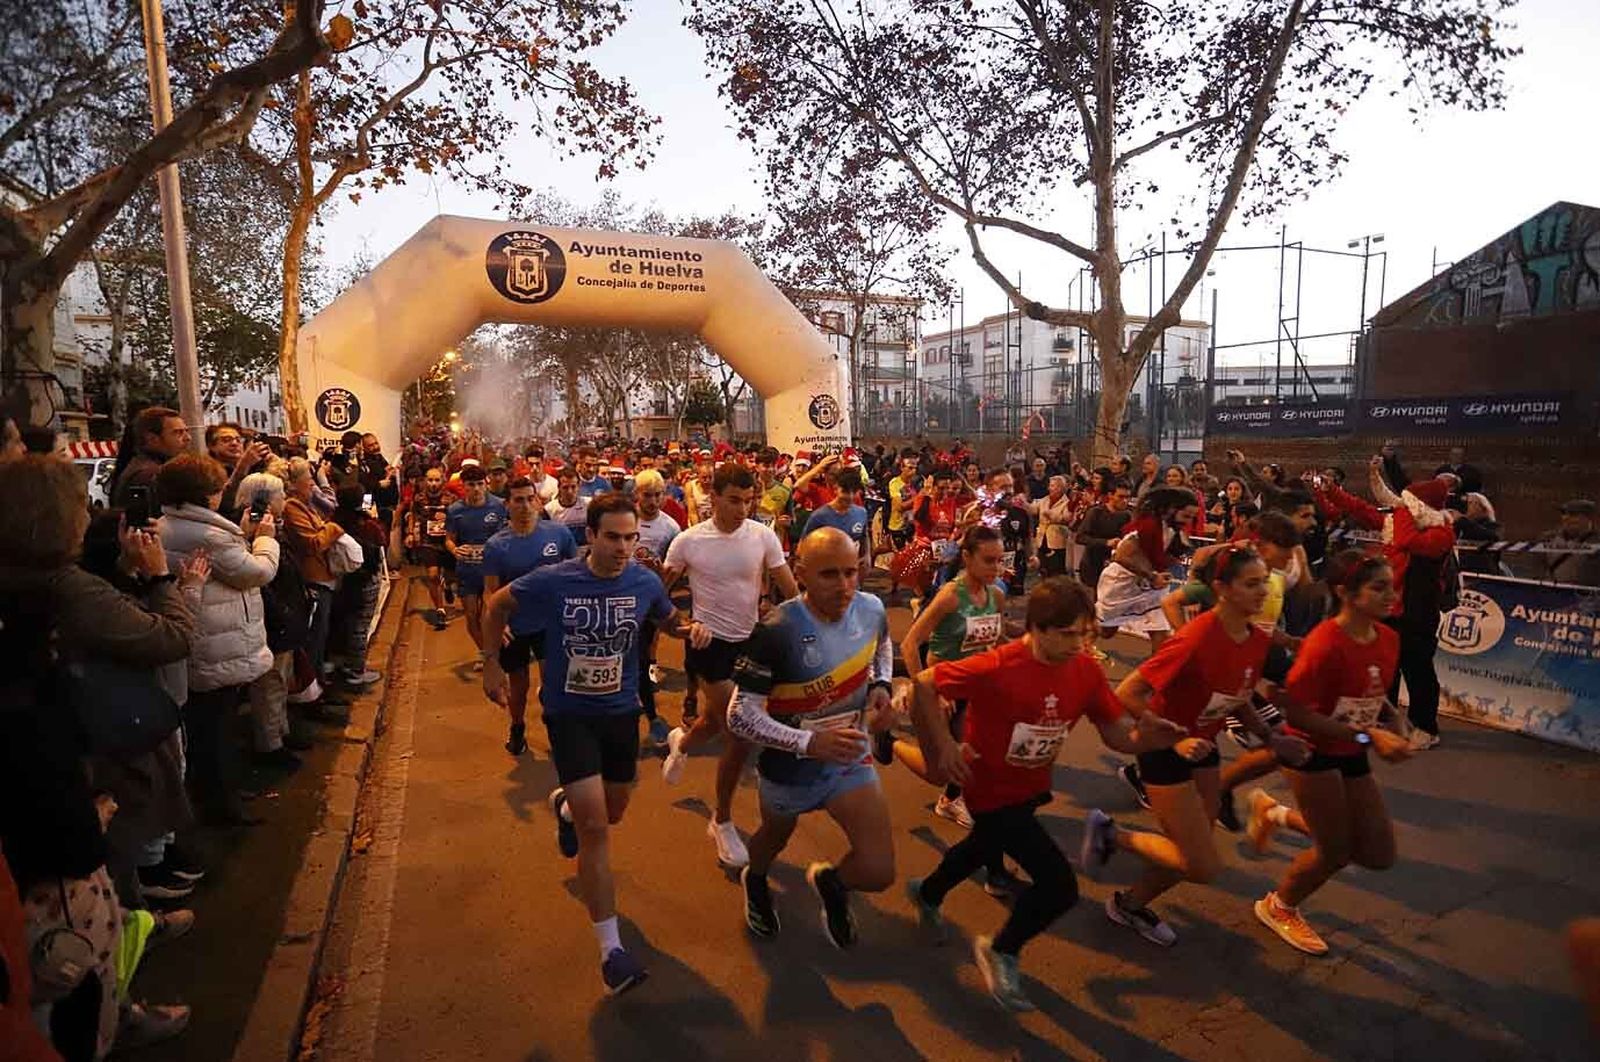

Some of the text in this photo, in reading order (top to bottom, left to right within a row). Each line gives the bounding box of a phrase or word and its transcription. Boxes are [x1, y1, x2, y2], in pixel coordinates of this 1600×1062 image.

[569, 241, 703, 262] Ayuntamiento
[610, 259, 704, 278] de Huelva
[640, 280, 653, 289] de
[657, 281, 706, 293] Deportes
[1300, 409, 1344, 419] HYUNDAI
[1392, 406, 1448, 416] HYUNDAI
[1491, 402, 1560, 414] HYUNDAI
[1232, 412, 1271, 421] HYUNDAI
[592, 668, 617, 683] 593
[803, 675, 836, 696] CLUB
